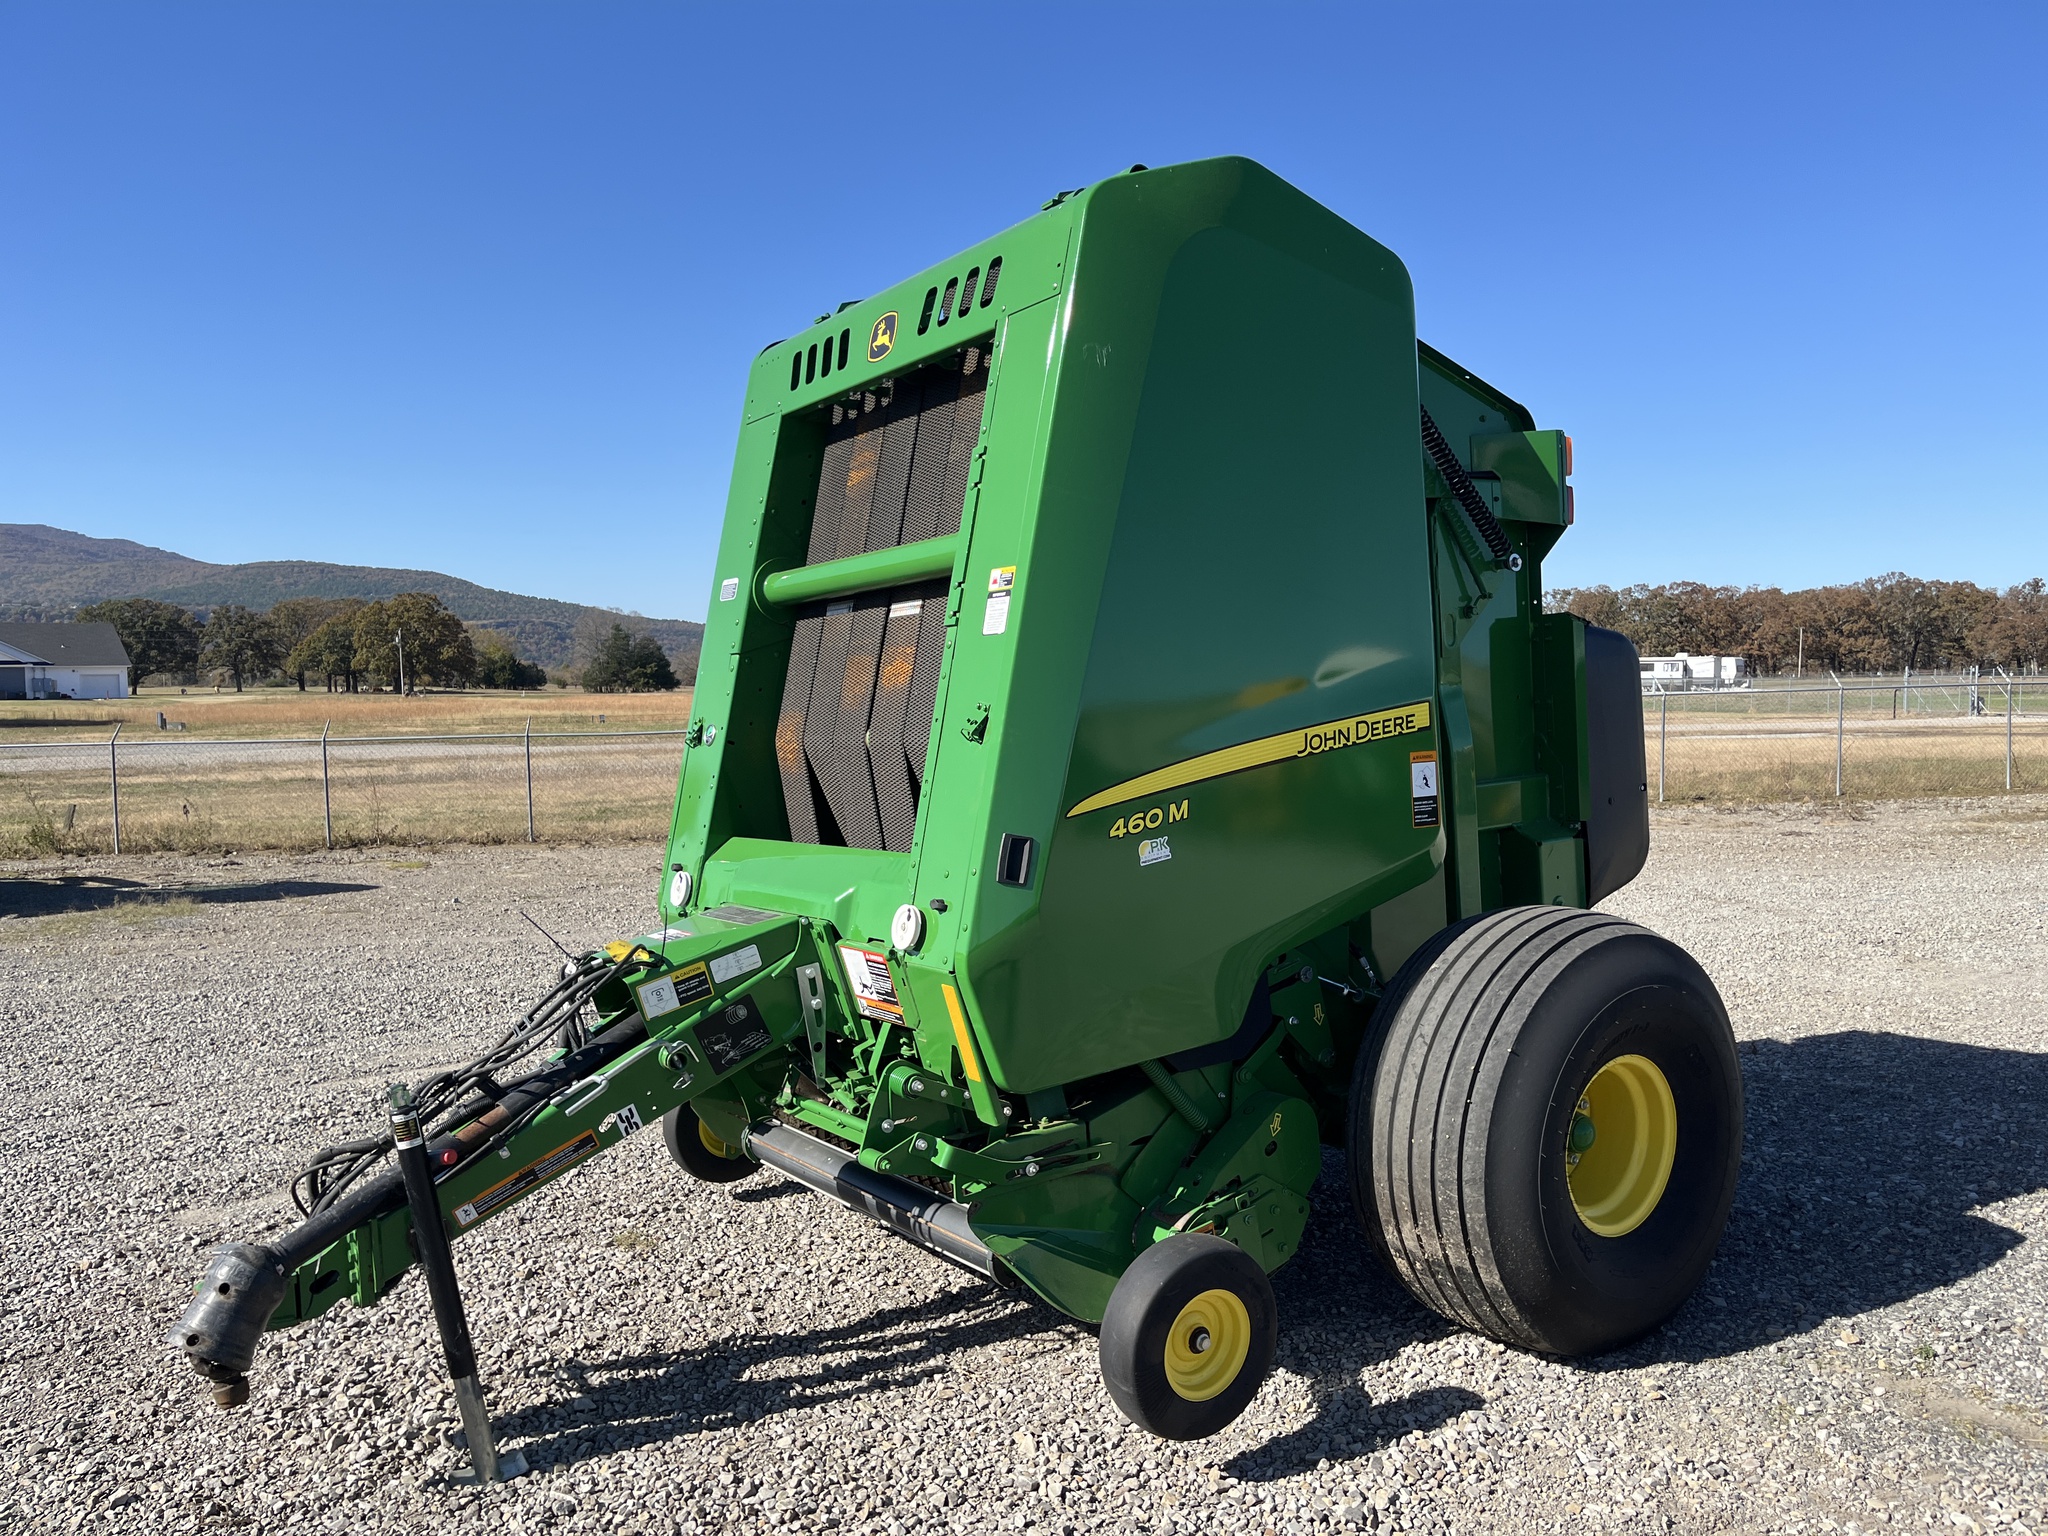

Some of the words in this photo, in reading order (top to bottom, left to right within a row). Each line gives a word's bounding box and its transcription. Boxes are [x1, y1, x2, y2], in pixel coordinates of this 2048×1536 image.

[1297, 726, 1351, 755] JOHN
[1355, 713, 1416, 742] DEERE
[1108, 807, 1164, 838] 460
[1168, 799, 1189, 824] M
[1150, 837, 1168, 854] PK
[679, 966, 702, 978] CAUTION
[521, 1156, 546, 1173] WARNING
